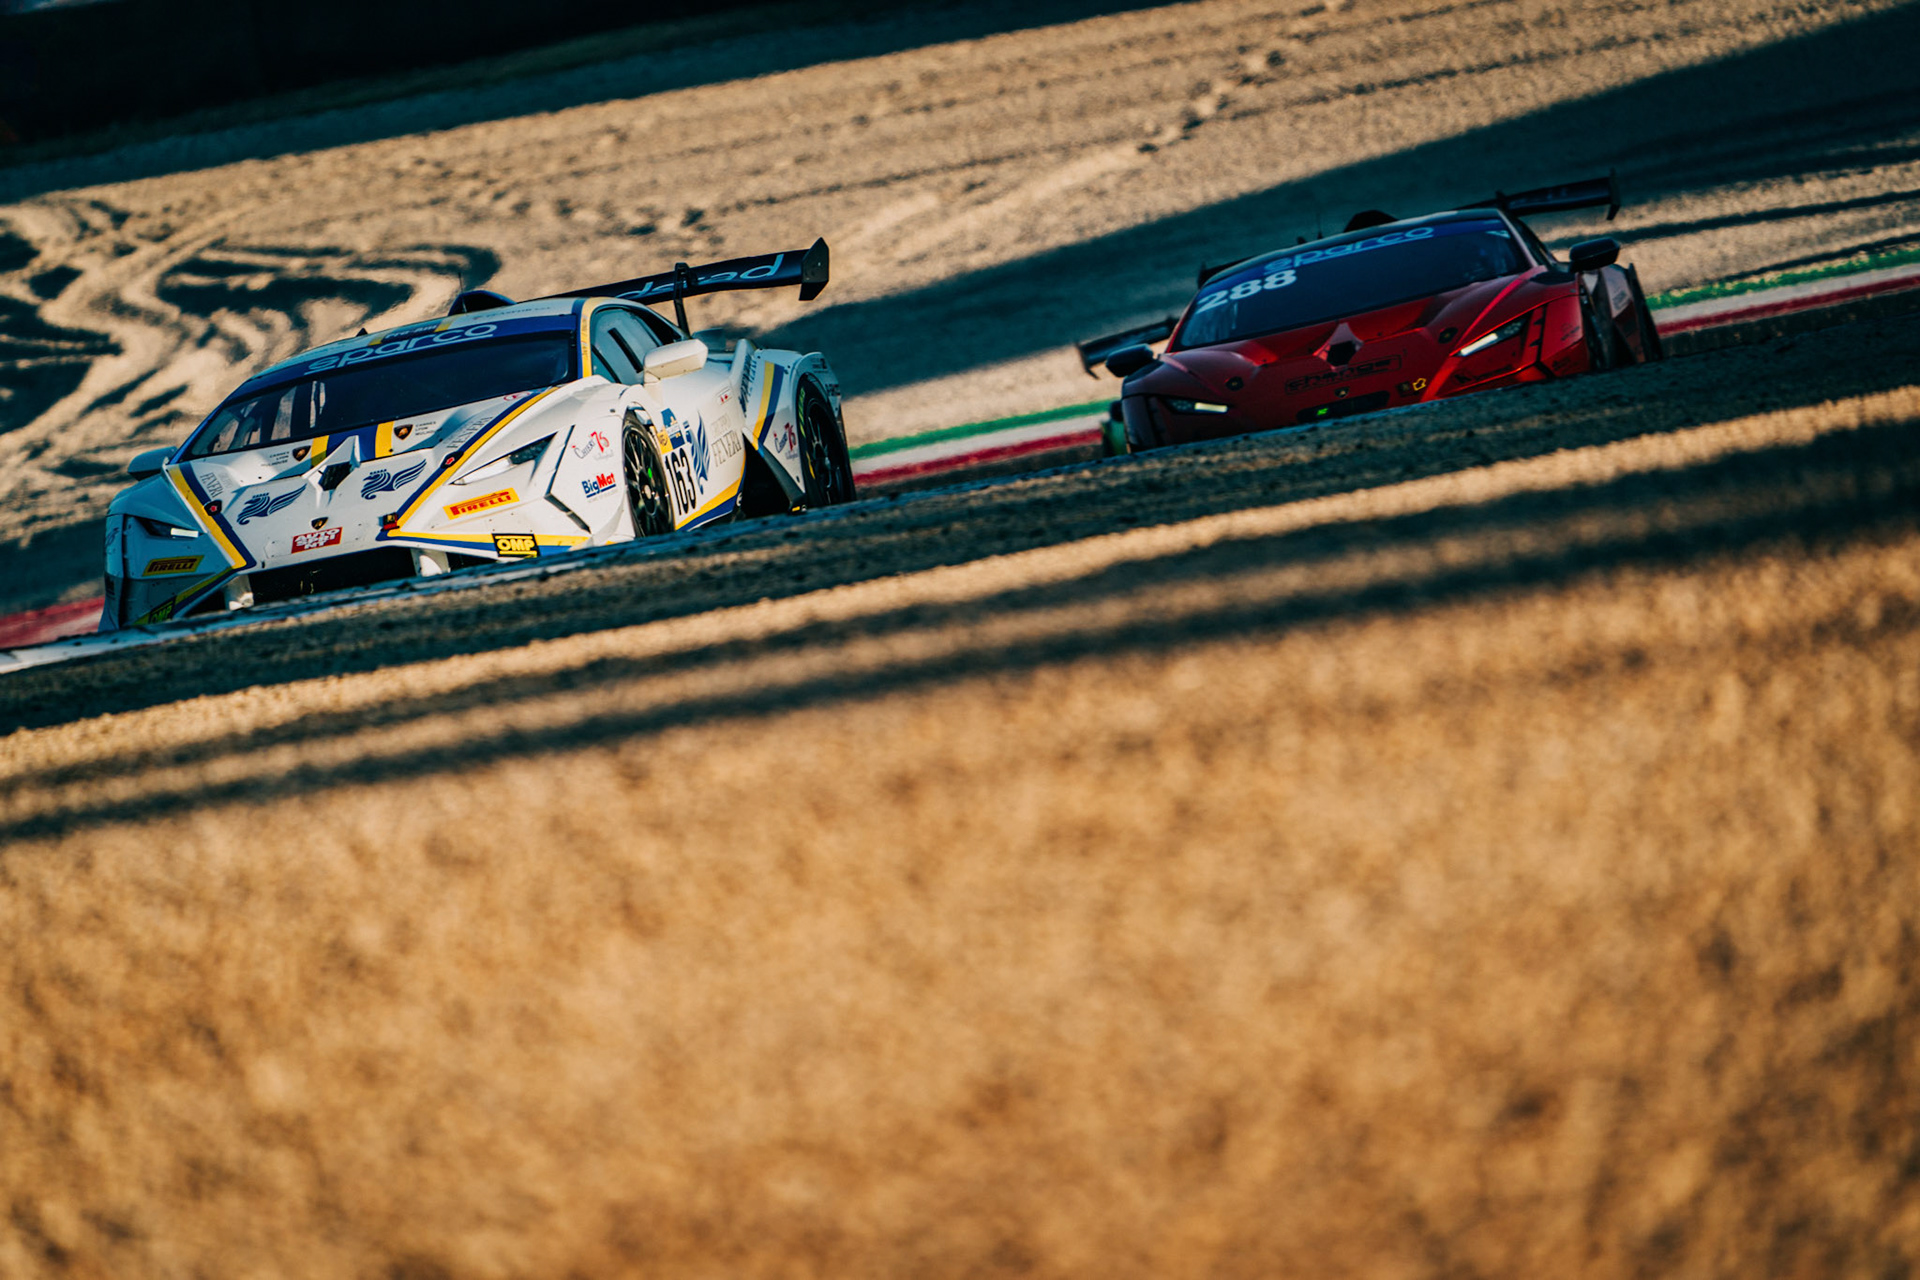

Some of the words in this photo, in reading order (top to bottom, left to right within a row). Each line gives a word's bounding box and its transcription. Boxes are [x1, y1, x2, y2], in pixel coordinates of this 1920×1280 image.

[1194, 269, 1297, 315] 288
[305, 323, 496, 372] sparco
[582, 473, 616, 495] BigMat
[665, 447, 696, 516] 163
[448, 491, 512, 516] PIRELLI
[497, 538, 535, 551] OMP
[148, 559, 197, 572] PIRELLI
